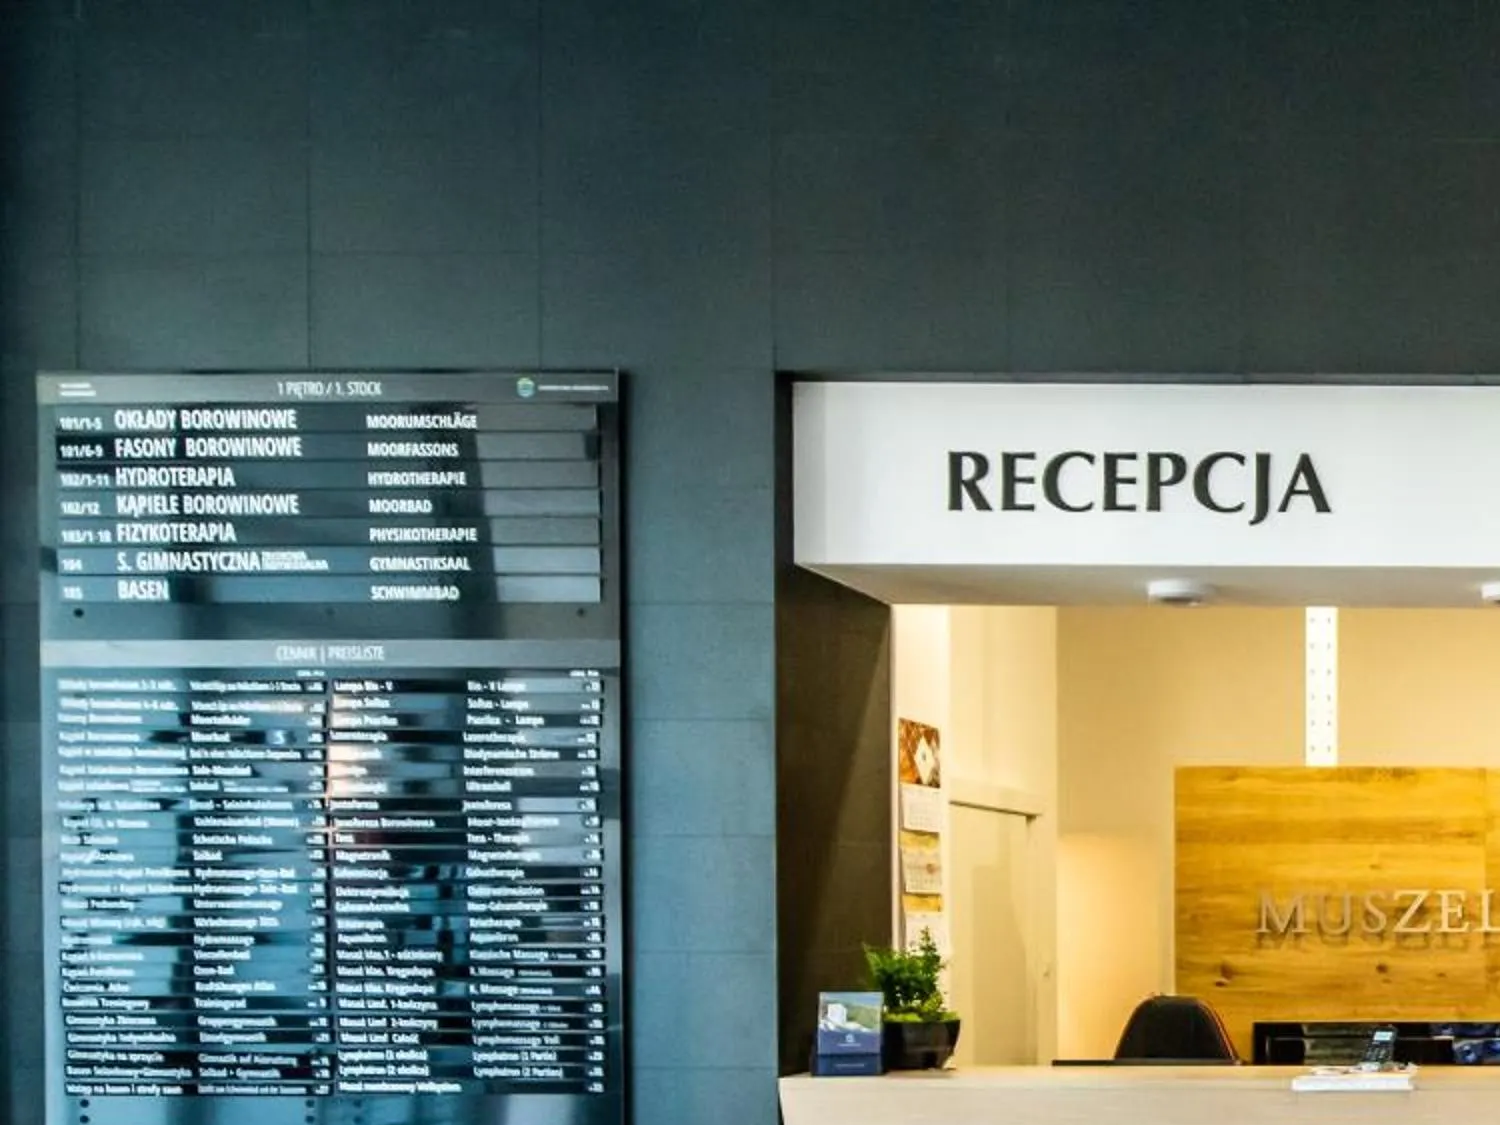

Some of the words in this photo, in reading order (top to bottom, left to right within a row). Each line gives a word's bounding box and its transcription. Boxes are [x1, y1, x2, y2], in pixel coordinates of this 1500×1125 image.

[347, 381, 382, 396] STOCK
[114, 409, 177, 429] OKŁADY
[180, 409, 298, 429] BOROWINOWE
[366, 412, 478, 430] MOORUMSCHLÄGE
[115, 437, 177, 457] FASONY
[184, 436, 302, 457] BOROWINOWE
[367, 442, 460, 457] MOORFASSONS
[115, 466, 237, 487] HYDROTERAPIA
[367, 471, 467, 486] HYDROTHERAPIE
[948, 450, 1331, 526] RECEPCJA
[116, 494, 180, 518] KĄPIELE
[183, 494, 300, 514] BOROWINOWE
[368, 499, 433, 513] MOORBAD
[116, 522, 238, 543] FIZYKOTERAPIA
[369, 527, 478, 542] PHYSIKOTHERAPIE
[117, 551, 132, 572] S.
[136, 551, 261, 572] GIMNASTYCZNA
[369, 556, 471, 572] GYMNASTIKSAAL
[117, 579, 169, 600] BASEN
[370, 585, 460, 600] SCHWIMMBAD
[327, 645, 386, 661] PREISLISTE
